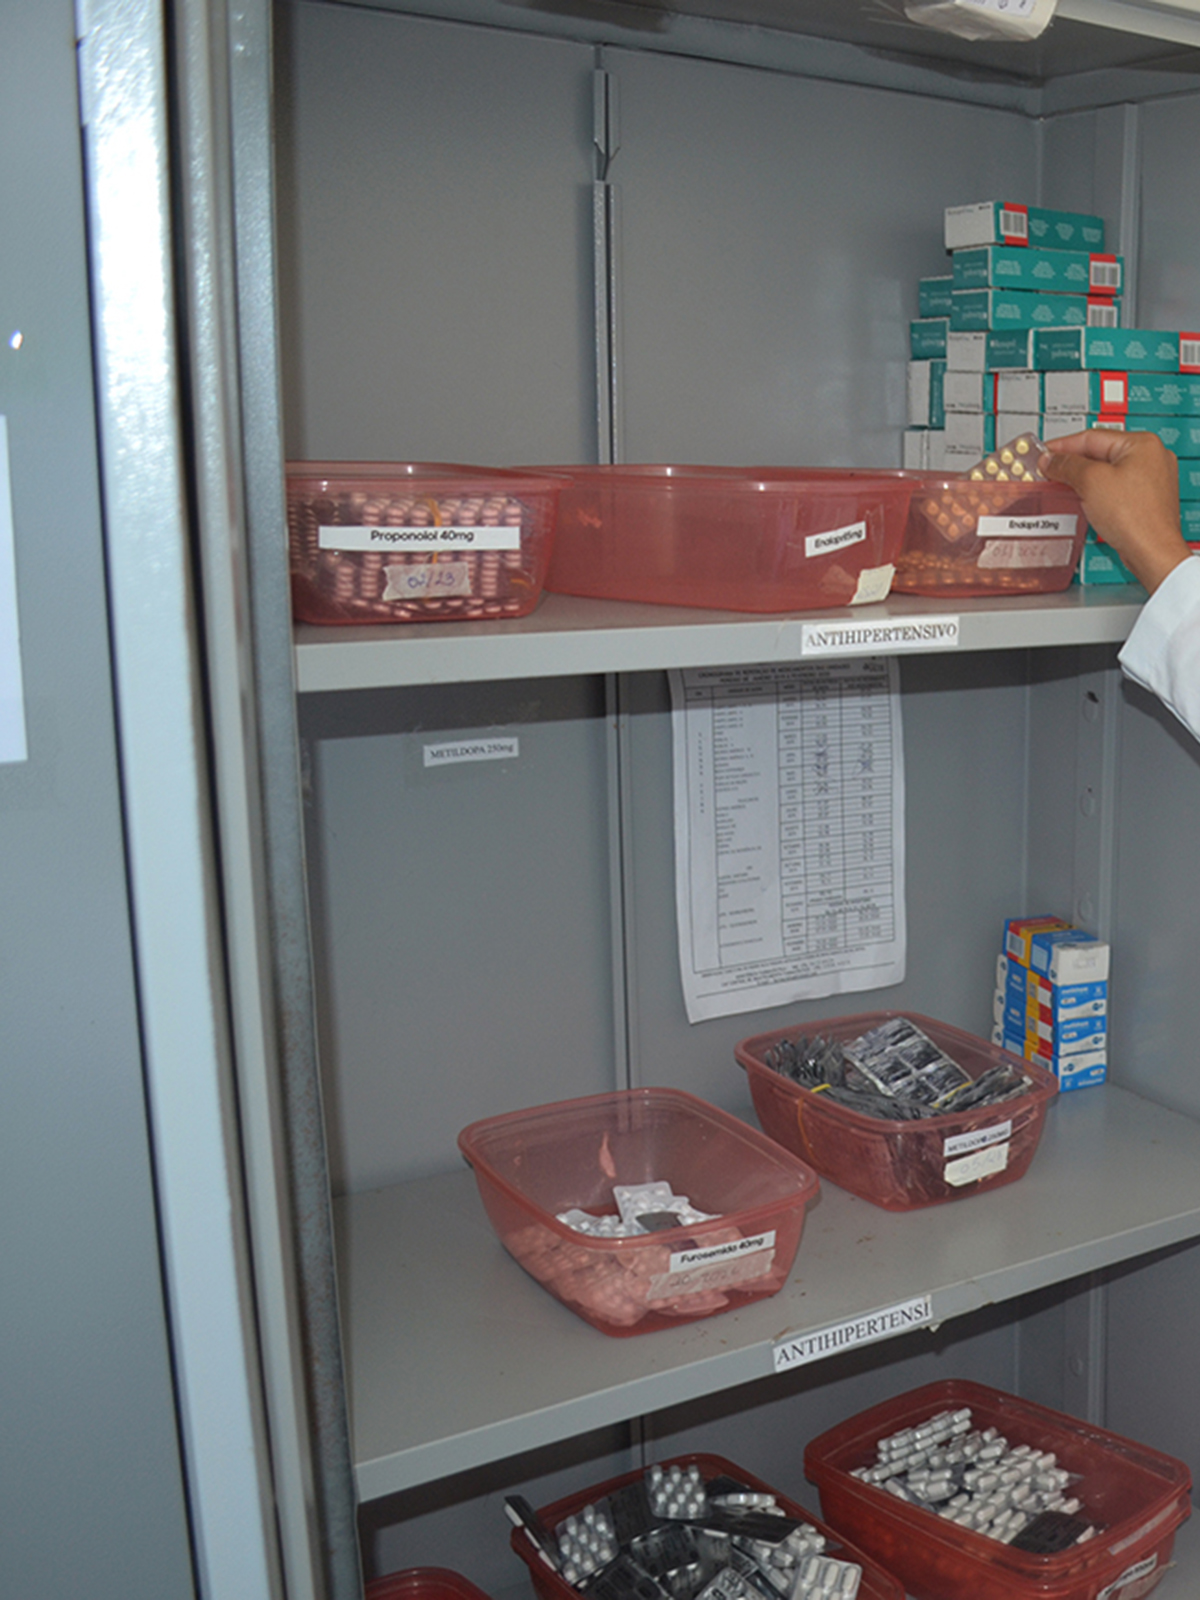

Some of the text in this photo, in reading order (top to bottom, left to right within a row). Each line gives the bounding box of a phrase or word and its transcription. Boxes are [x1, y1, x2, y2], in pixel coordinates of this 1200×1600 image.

[370, 530, 475, 542] Proponolol 40mg
[806, 622, 957, 647] ANTIHIPERTENSIVO
[680, 1244, 738, 1263] Furosemida
[776, 1302, 931, 1365] ANTIHIPERTENSI
